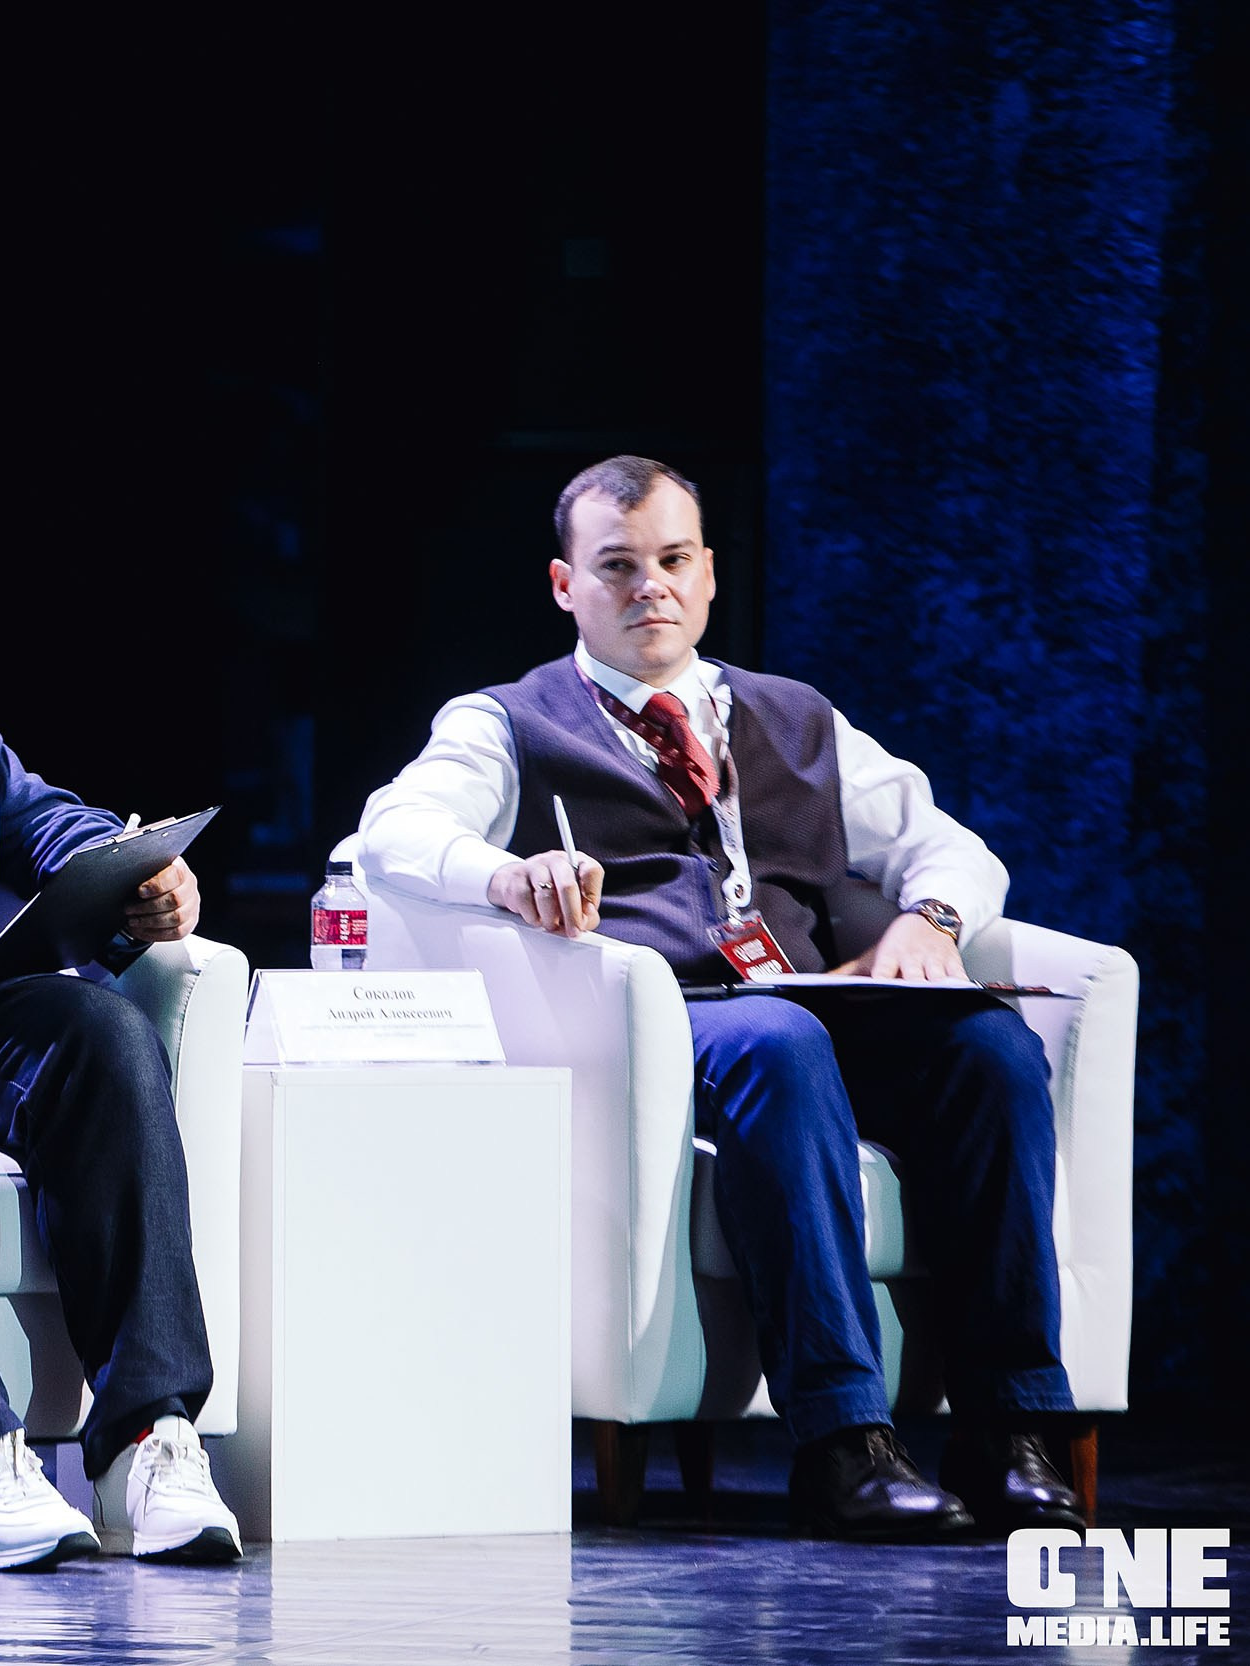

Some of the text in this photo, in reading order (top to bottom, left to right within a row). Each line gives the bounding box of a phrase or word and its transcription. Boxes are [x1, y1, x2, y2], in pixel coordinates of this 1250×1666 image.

[352, 985, 416, 1001] Соколов
[327, 1007, 453, 1022] Андрей Алексеевич
